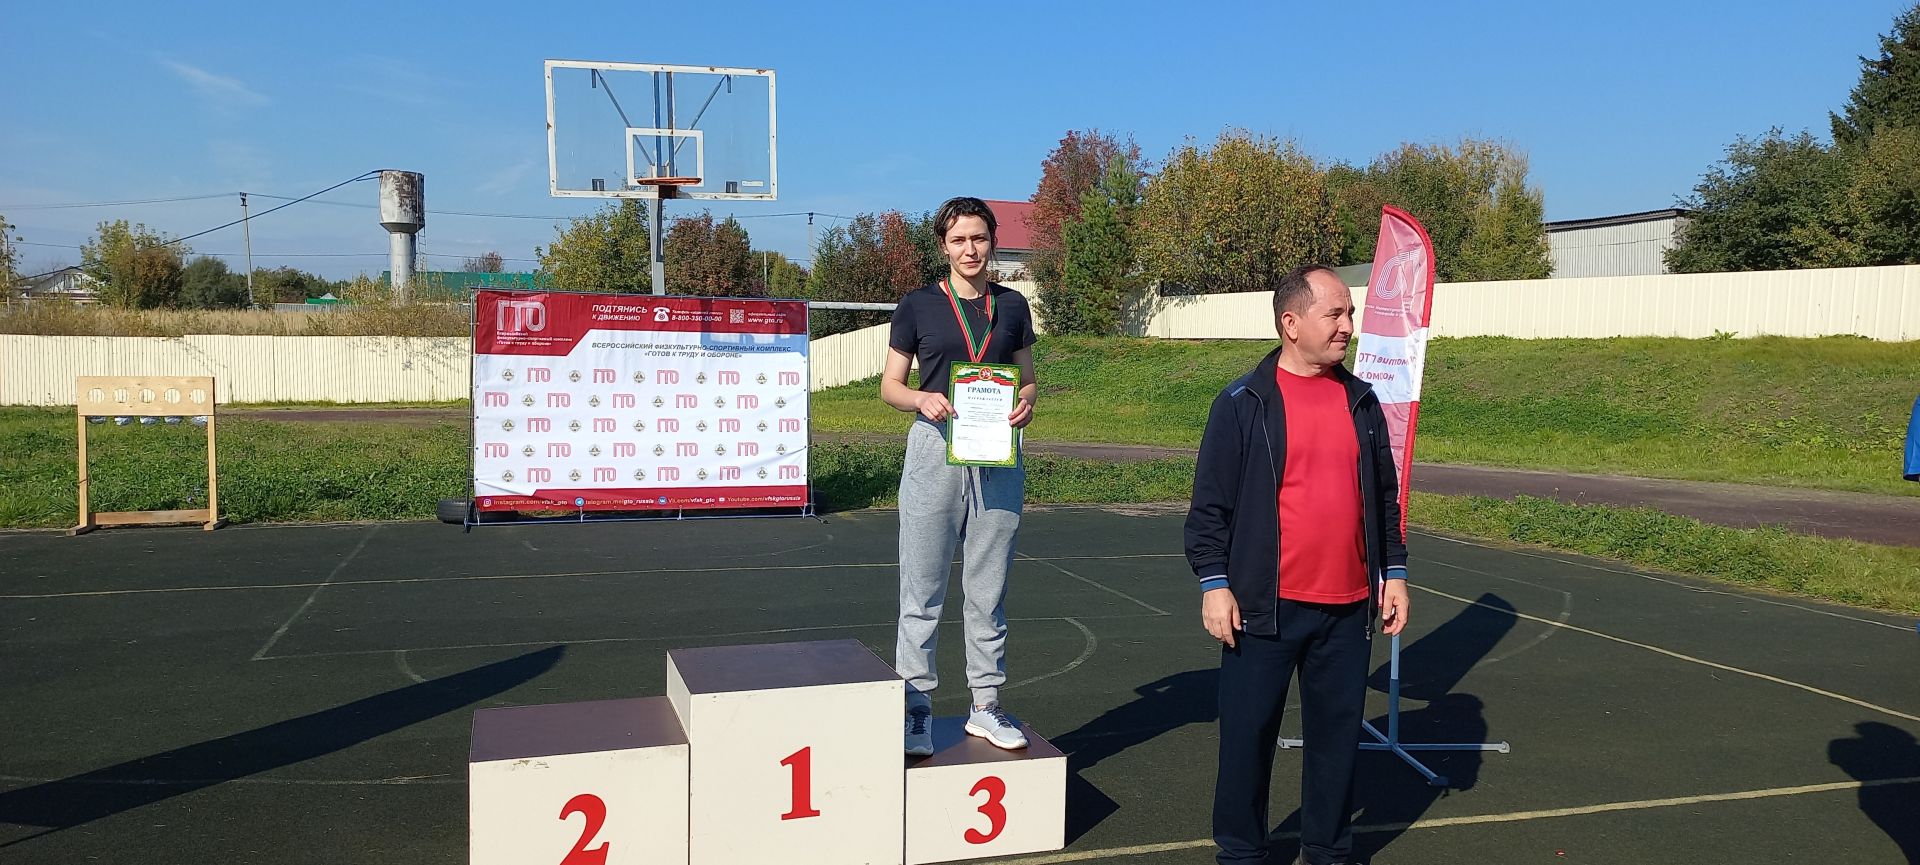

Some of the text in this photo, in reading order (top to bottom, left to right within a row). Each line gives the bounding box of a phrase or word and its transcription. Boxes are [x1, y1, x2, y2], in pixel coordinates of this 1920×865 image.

[496, 299, 546, 331] ГТО
[592, 304, 647, 314] ПОДТЯНИСЬ
[598, 314, 640, 322] ДВИЖЕНИЮ
[592, 342, 653, 350] ВСЕРОССИЙСКИЙ
[654, 343, 756, 352] ФИЗКУЛЬТУРНО-СПОРТИВНЫЙ
[528, 368, 551, 382] ГТО
[594, 369, 616, 383] ГТО
[657, 370, 679, 384] ГТО
[718, 371, 740, 384] ГТО
[778, 372, 799, 385] ГТО
[968, 386, 1001, 394] ГРАМОТА
[485, 392, 508, 407] ГТО
[548, 393, 570, 407] ГТО
[613, 394, 635, 408] ГТО
[676, 394, 697, 408] ГТО
[737, 395, 758, 409] ГТО
[528, 418, 551, 432] ГТО
[594, 418, 616, 432] ГТО
[657, 419, 679, 432] ГТО
[719, 419, 740, 432] ГТО
[778, 418, 800, 432] ГТО
[485, 443, 508, 457] ГТО
[548, 443, 571, 457] ГТО
[613, 443, 635, 457] ГТО
[676, 443, 698, 456] ГТО
[738, 442, 758, 456] ГТО
[528, 468, 551, 482] ГТО
[594, 468, 616, 482] ГТО
[658, 467, 679, 481] ГТО
[720, 466, 740, 480] ГТО
[778, 465, 800, 479] ГТО
[780, 746, 820, 820] 1
[964, 776, 1007, 845] 3
[558, 794, 610, 865] 2
